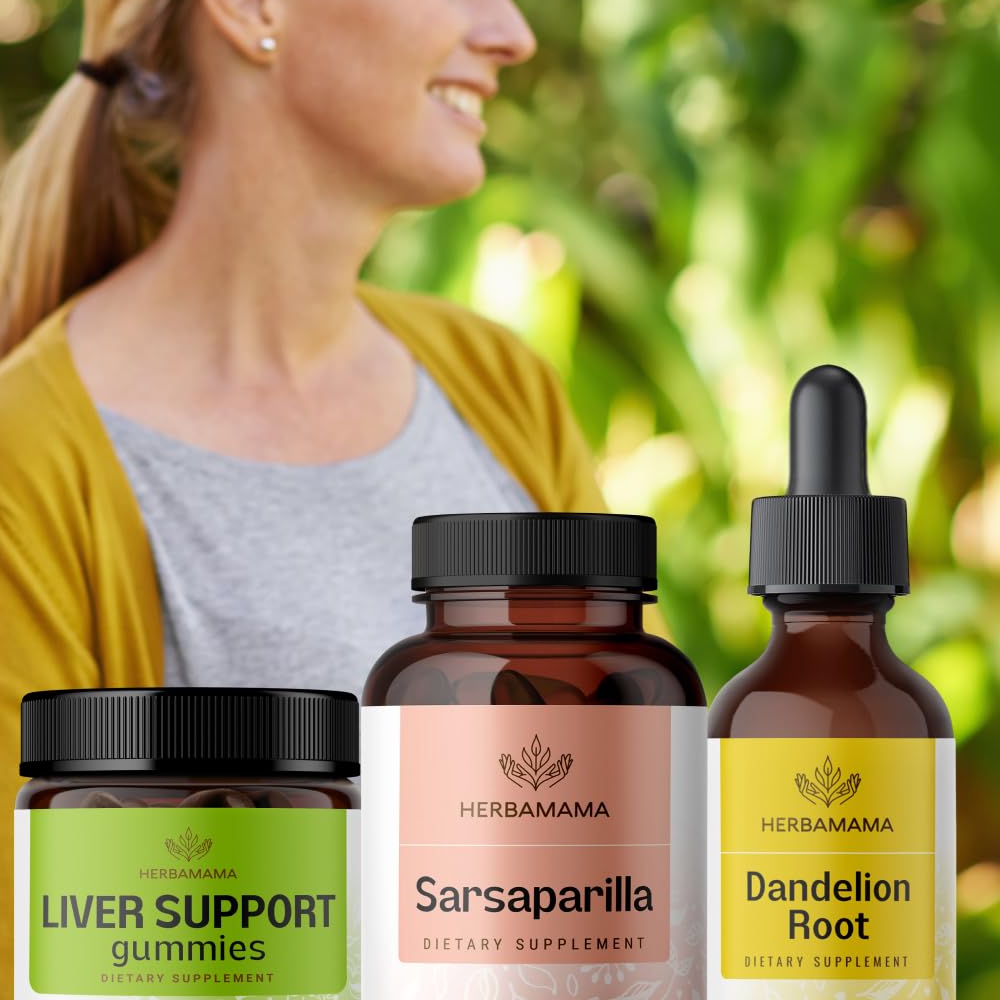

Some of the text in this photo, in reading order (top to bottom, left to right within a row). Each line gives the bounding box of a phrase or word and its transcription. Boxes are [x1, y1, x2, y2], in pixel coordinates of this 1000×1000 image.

[459, 801, 611, 818] HERBAMAMA
[761, 817, 894, 833] HERBAMAMA
[139, 868, 238, 880] HERBAMAMA
[746, 871, 911, 902] Dandelion
[415, 875, 653, 920] Sarsaparilla
[41, 894, 337, 929] LIVER SUPPORT
[788, 909, 869, 940] Root
[111, 934, 266, 967] gummies
[423, 937, 646, 951] DIETARY SUPPLEMENT
[744, 956, 908, 968] DIETARY SUPPLEMENT
[100, 973, 274, 983] DIETARY SUPPLEMENT
